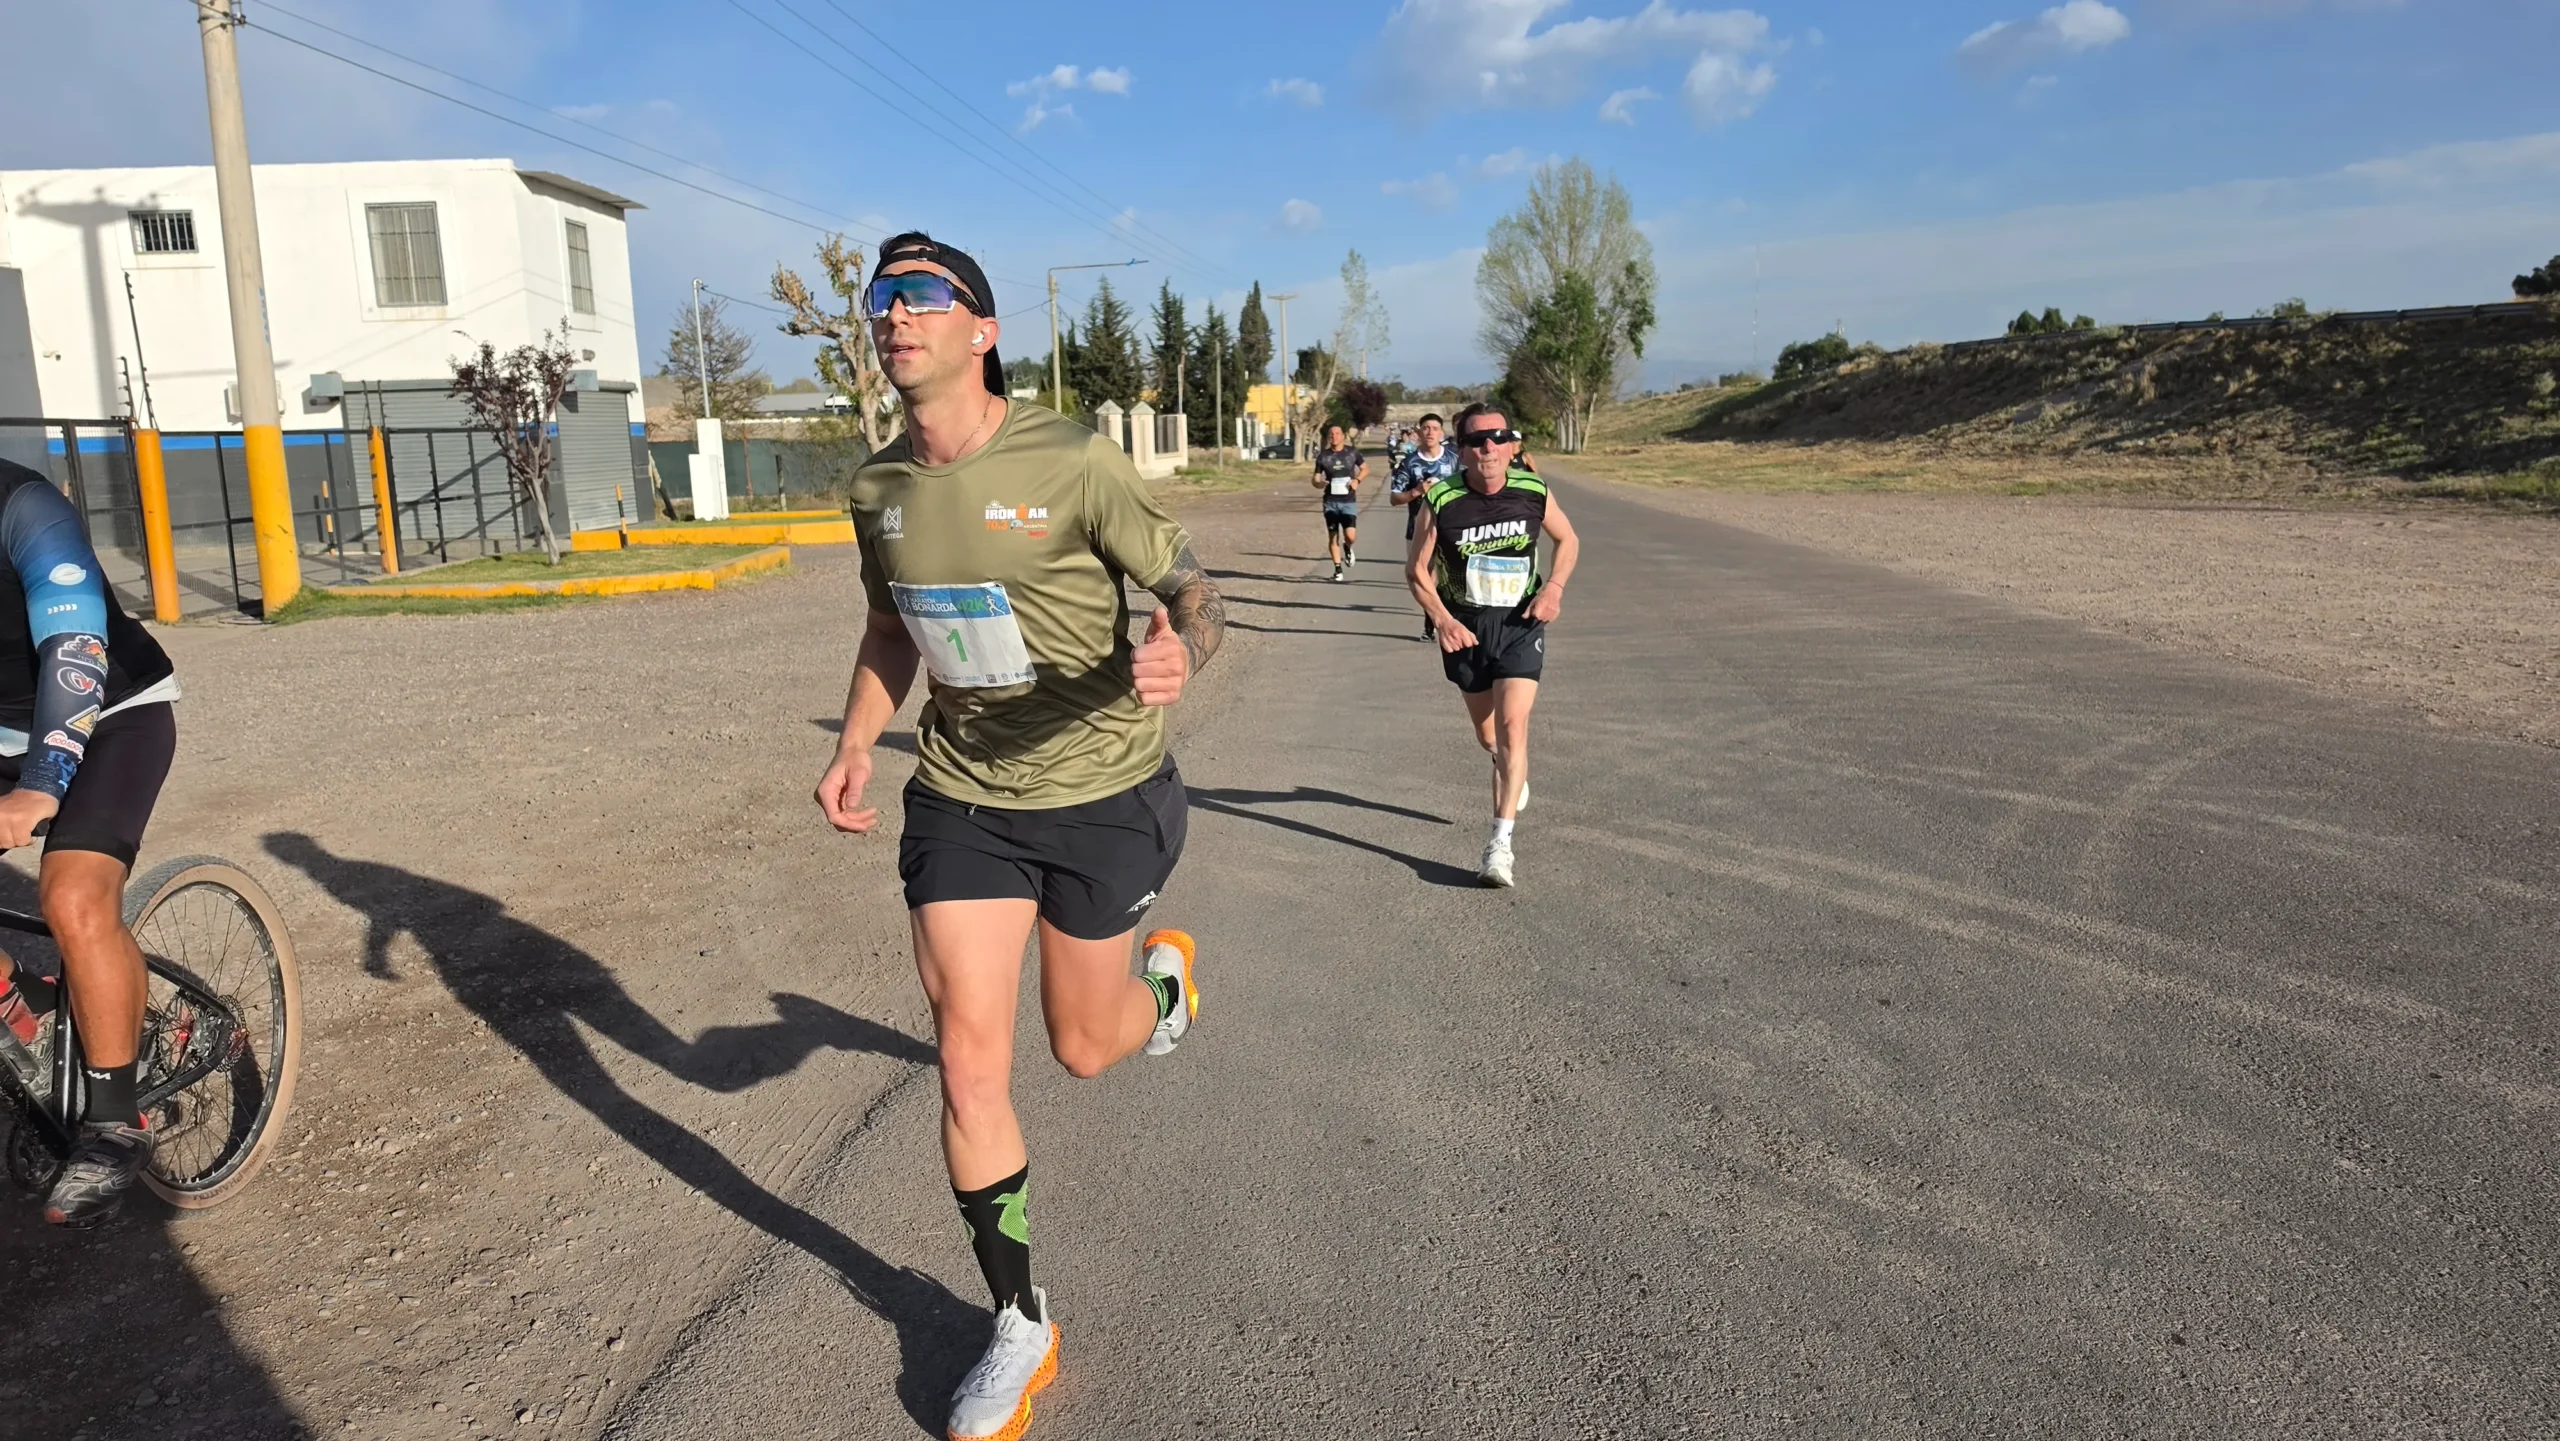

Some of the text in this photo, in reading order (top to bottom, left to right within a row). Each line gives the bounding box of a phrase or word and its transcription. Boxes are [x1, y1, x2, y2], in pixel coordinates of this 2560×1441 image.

[1455, 520, 1527, 545] JUNIN
[1457, 533, 1531, 559] Running
[911, 597, 988, 613] BONARDA 42K
[946, 628, 968, 662] 1
[193, 1172, 244, 1200] PHANTOM
